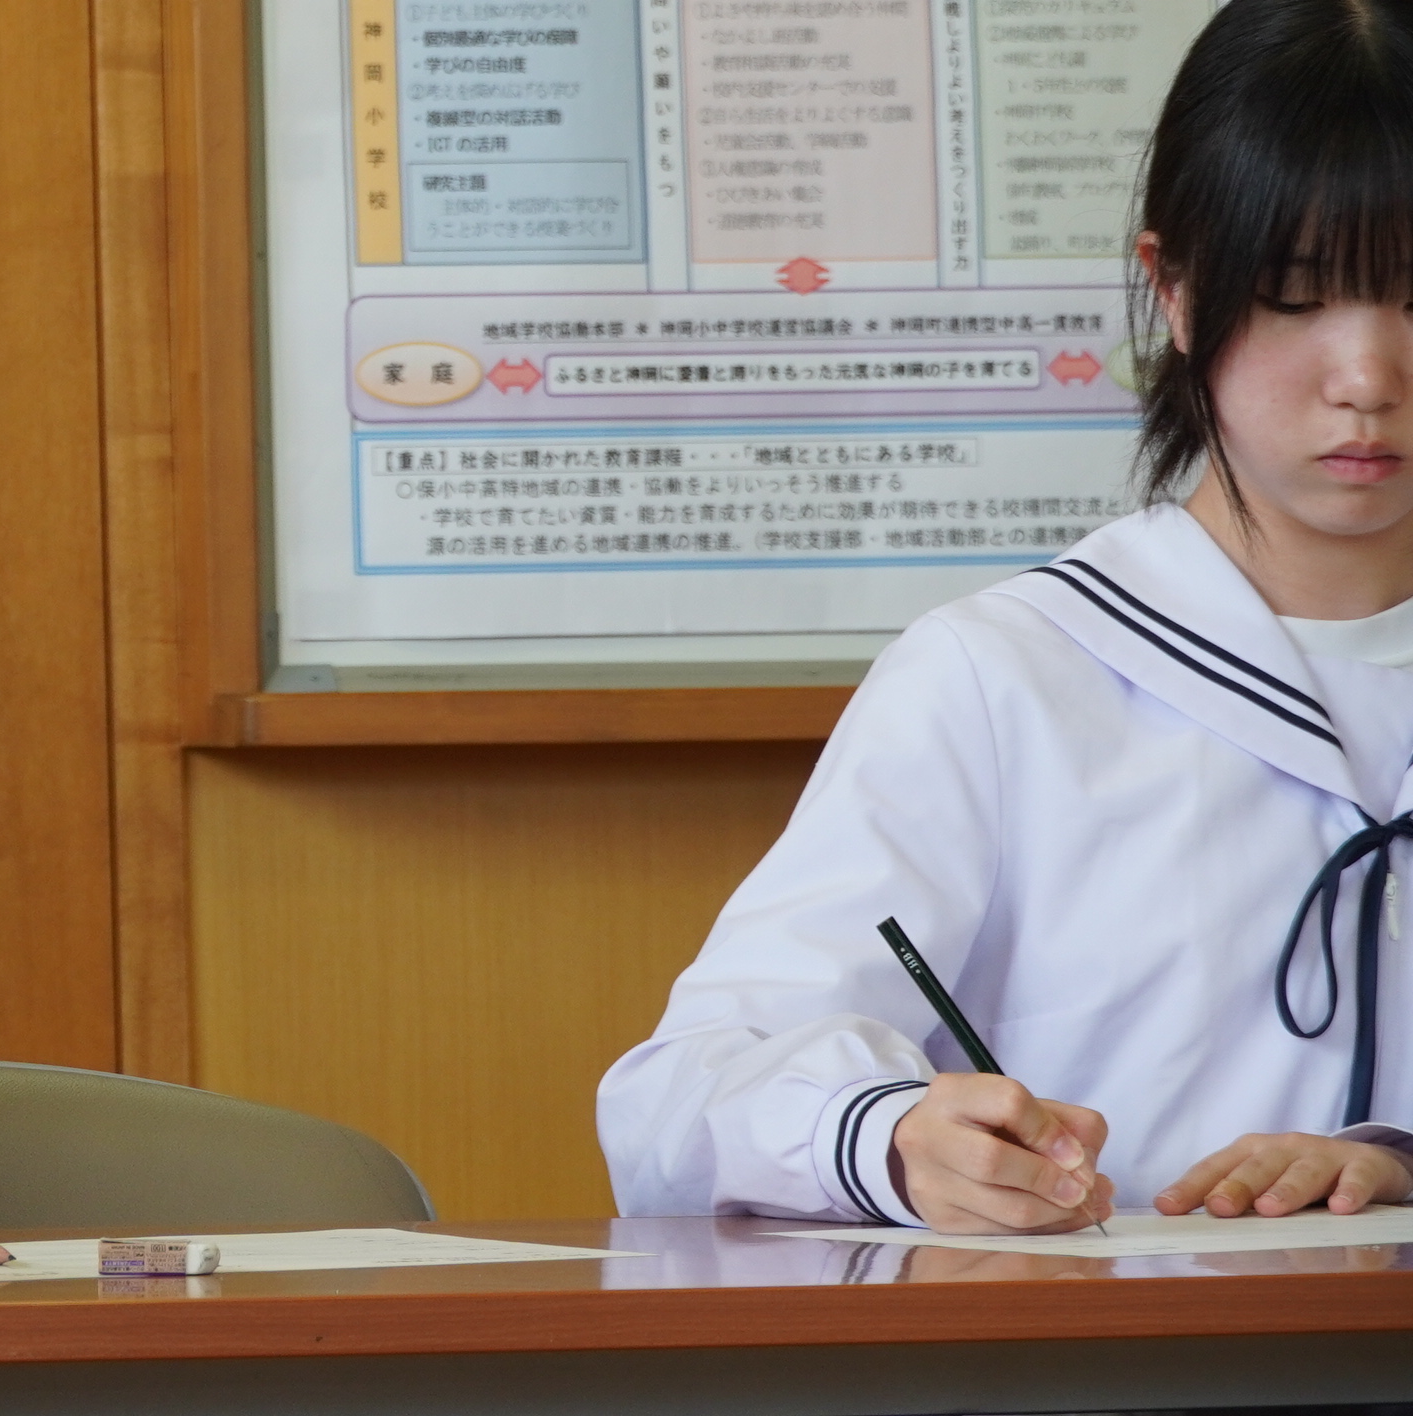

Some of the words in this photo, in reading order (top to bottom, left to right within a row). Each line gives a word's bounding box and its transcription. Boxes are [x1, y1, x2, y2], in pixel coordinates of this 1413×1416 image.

[363, 21, 390, 212] 神岡小学校
[381, 361, 456, 386] 家庭
